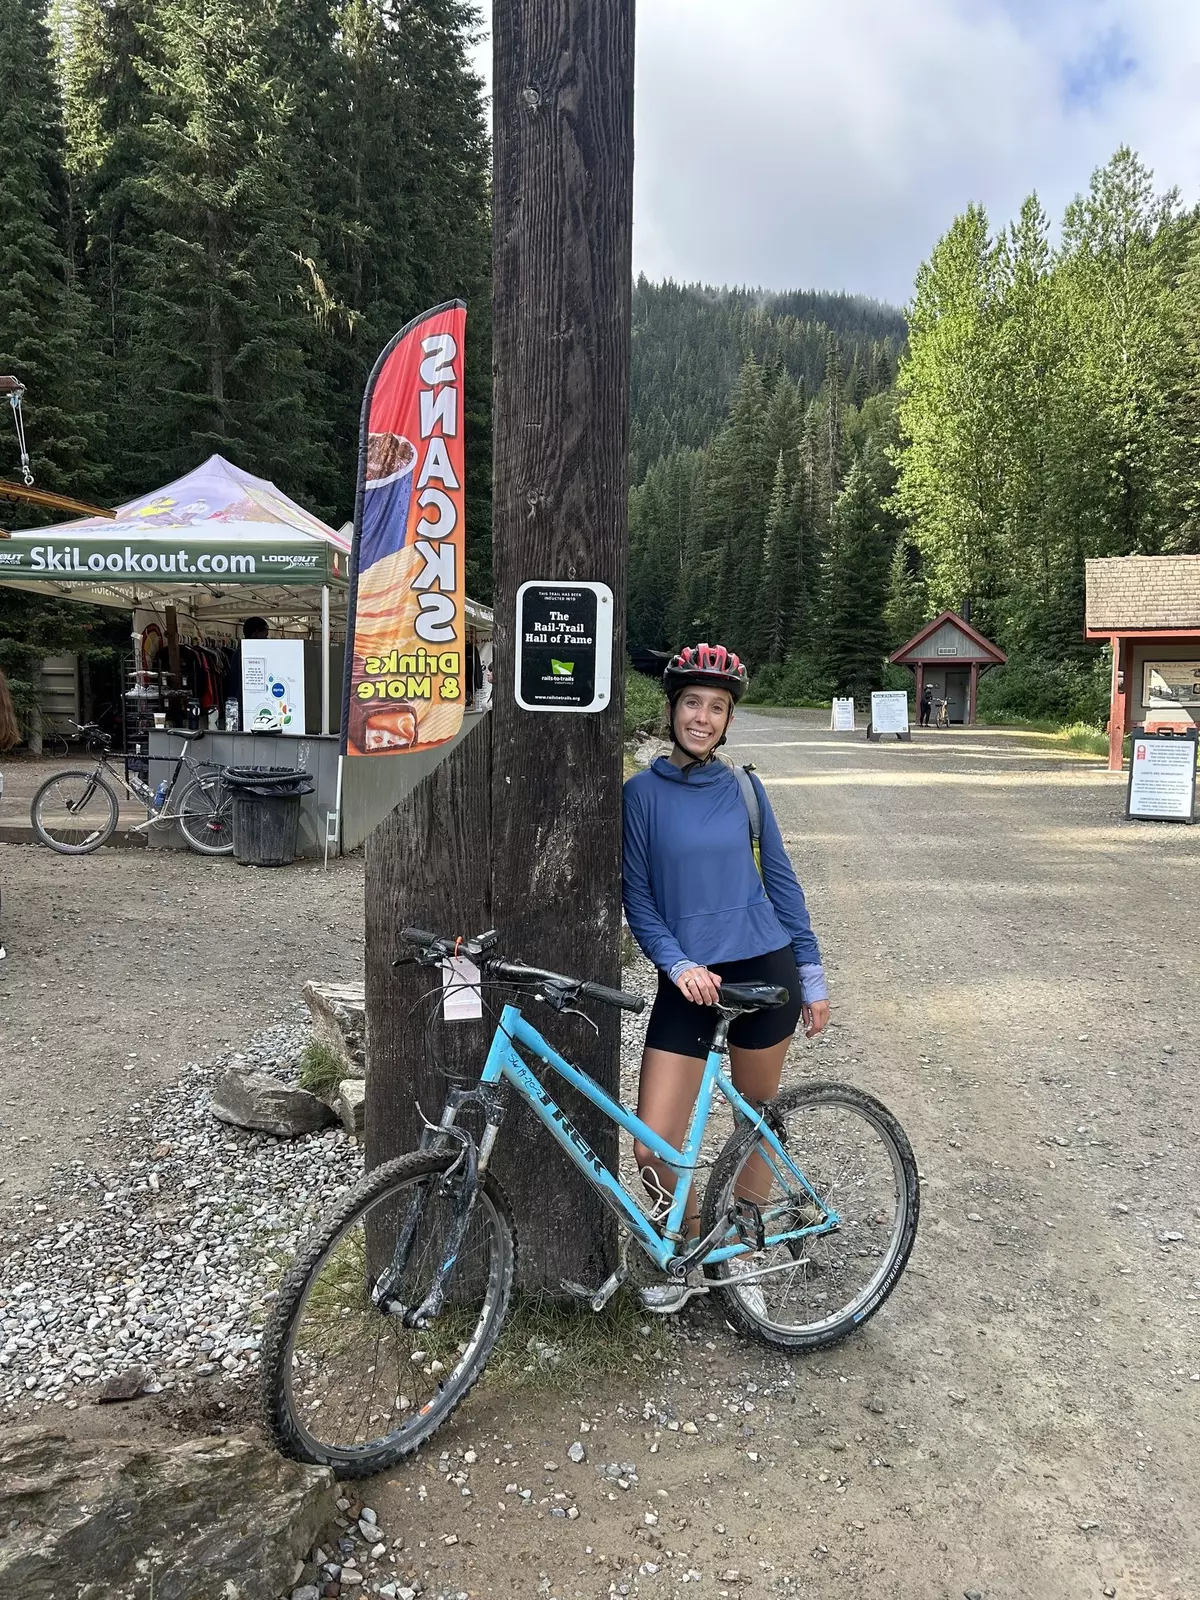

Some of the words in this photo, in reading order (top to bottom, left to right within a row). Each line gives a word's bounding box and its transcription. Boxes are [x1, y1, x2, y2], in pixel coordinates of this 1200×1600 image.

[30, 546, 256, 573] SkiLookout.com
[261, 554, 319, 563] LOOKOUT
[550, 611, 570, 621] The
[534, 622, 584, 633] Rail-Trail
[525, 633, 547, 643] Hall
[550, 634, 561, 644] of
[564, 634, 593, 644] Fame
[540, 1087, 606, 1176] TREK
